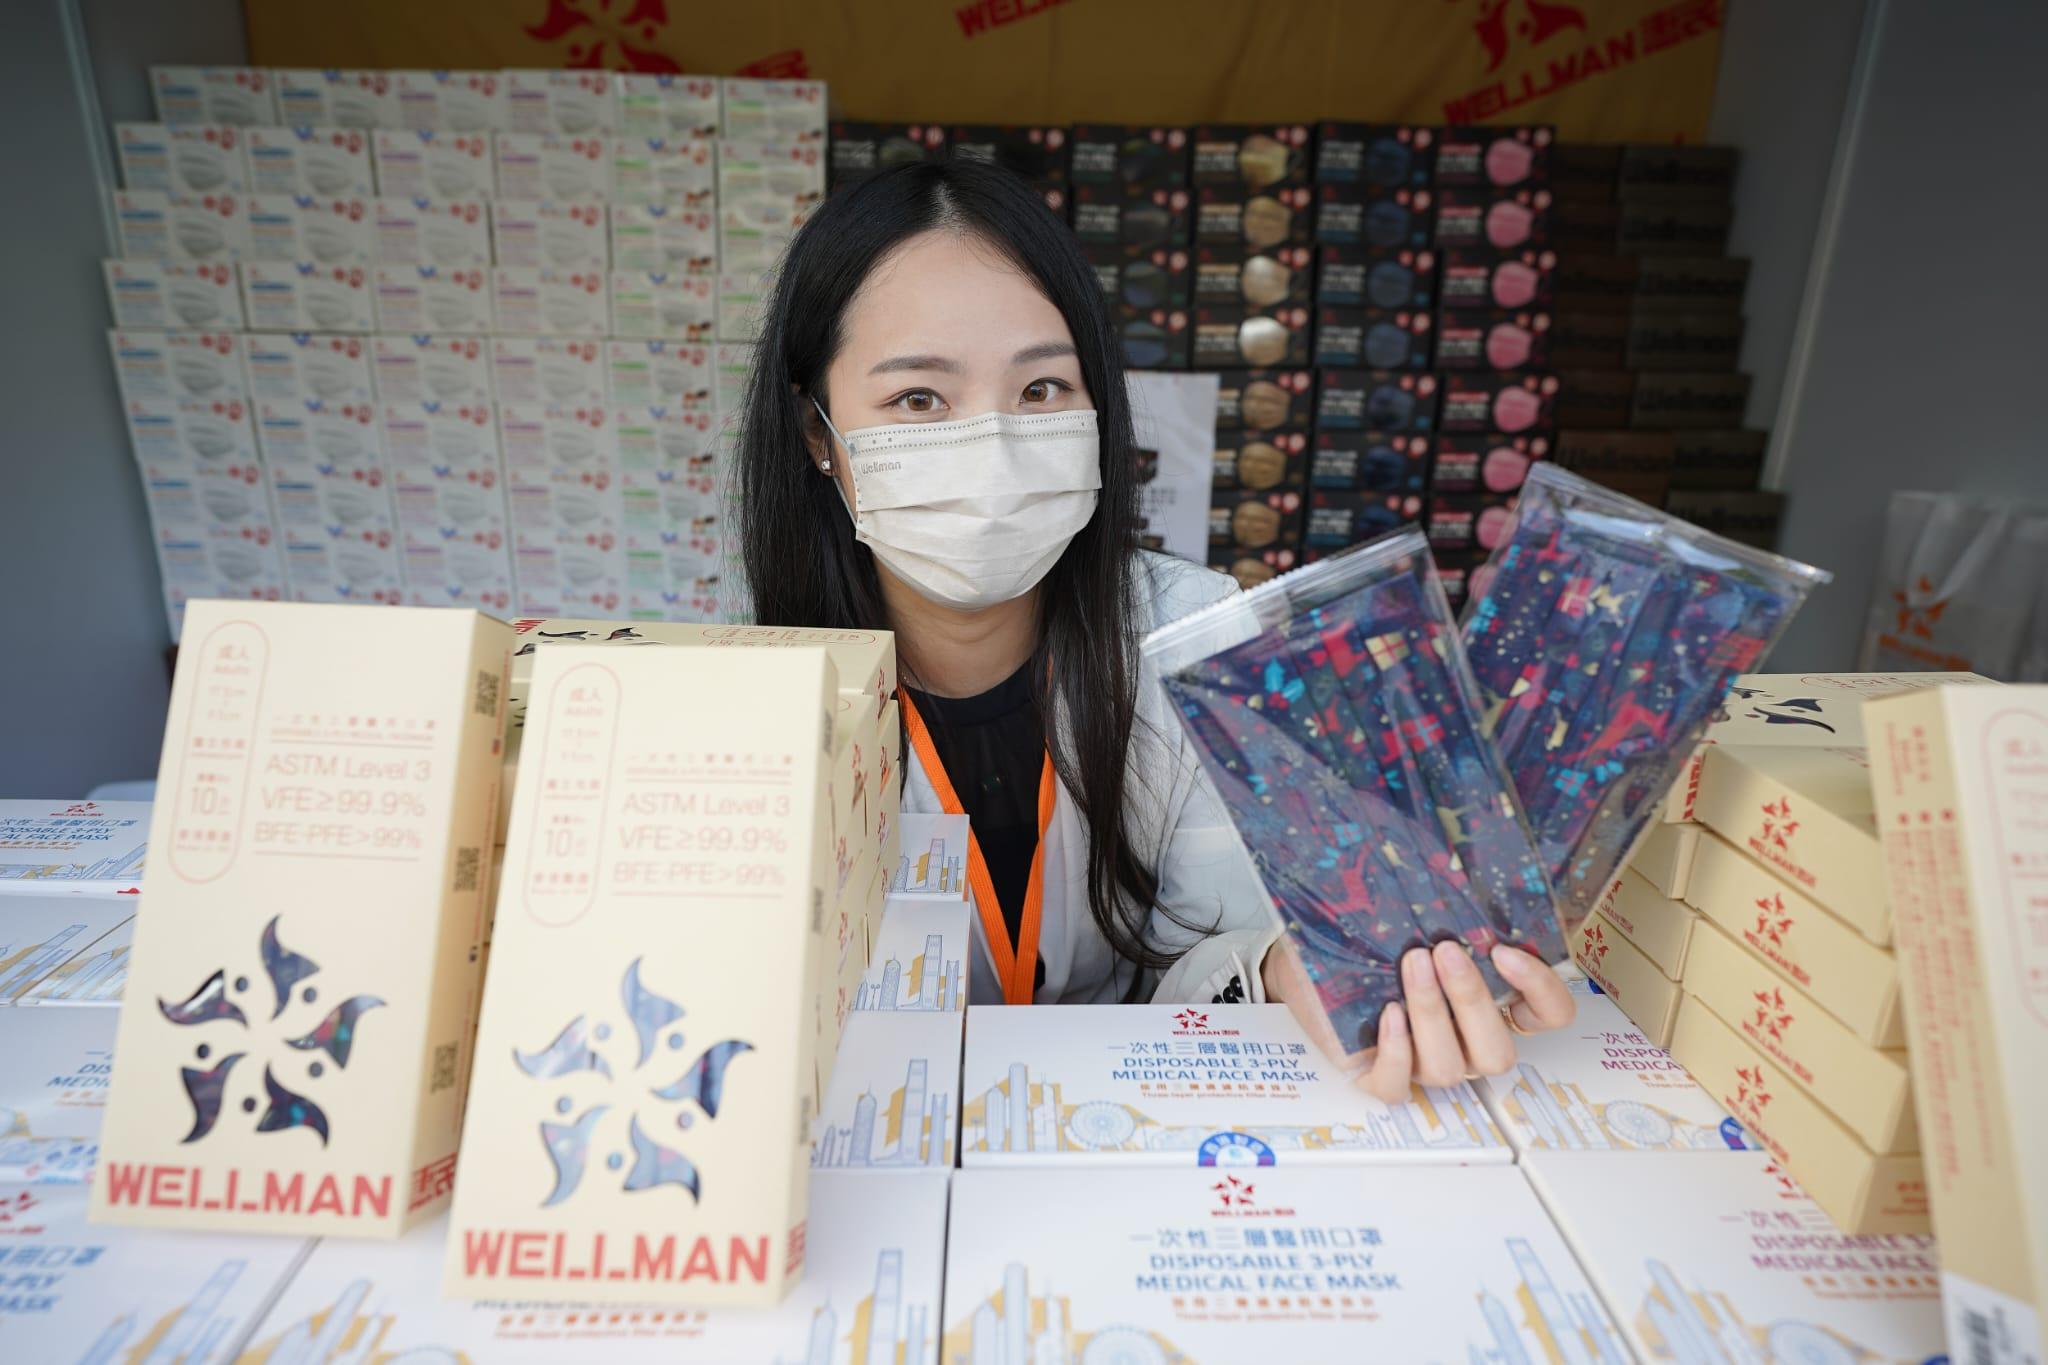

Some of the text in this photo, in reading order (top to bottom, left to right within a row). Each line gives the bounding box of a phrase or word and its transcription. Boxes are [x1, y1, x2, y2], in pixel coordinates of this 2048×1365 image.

[265, 753, 433, 782] ASTM Level 3
[191, 788, 219, 815] 10
[622, 792, 791, 818] ASTM Level 3
[545, 828, 574, 857] 10
[1107, 1041, 1307, 1056] 一次性三層醫用口罩
[1123, 1058, 1299, 1069] DISPOSABLE 3-PLY
[1112, 1070, 1319, 1081] MEDICAL FACE MASK
[107, 1161, 393, 1217] WELLMAN
[1130, 1227, 1384, 1248] 一次性三層醫用口罩
[464, 1229, 770, 1284] WELLMAN
[1149, 1253, 1376, 1270] DISPOSABLE 3-PLY
[1136, 1274, 1403, 1291] MEDICAL FACE MASK
